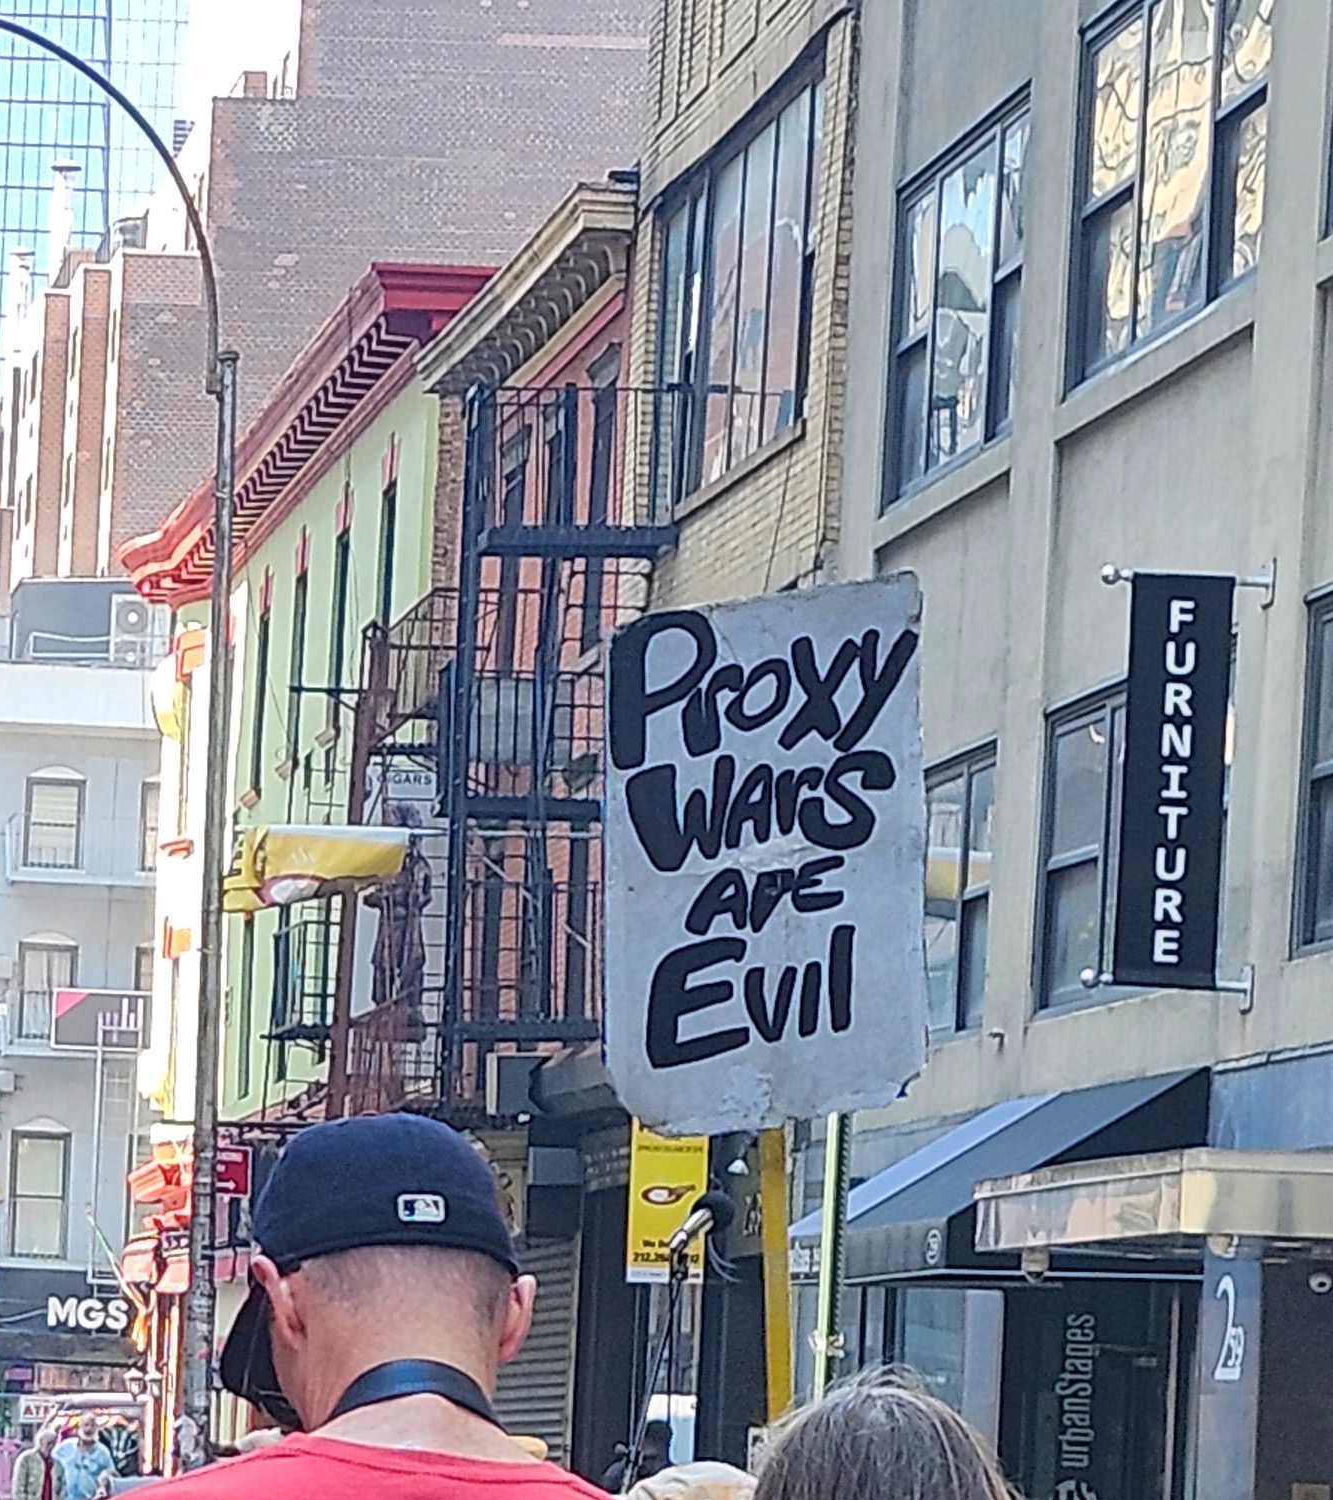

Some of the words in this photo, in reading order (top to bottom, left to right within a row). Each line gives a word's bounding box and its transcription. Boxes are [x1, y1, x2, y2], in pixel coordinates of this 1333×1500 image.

[1153, 599, 1196, 963] FURNITURE
[46, 1296, 129, 1330] MGS
[1054, 1312, 1097, 1469] urbanStages
